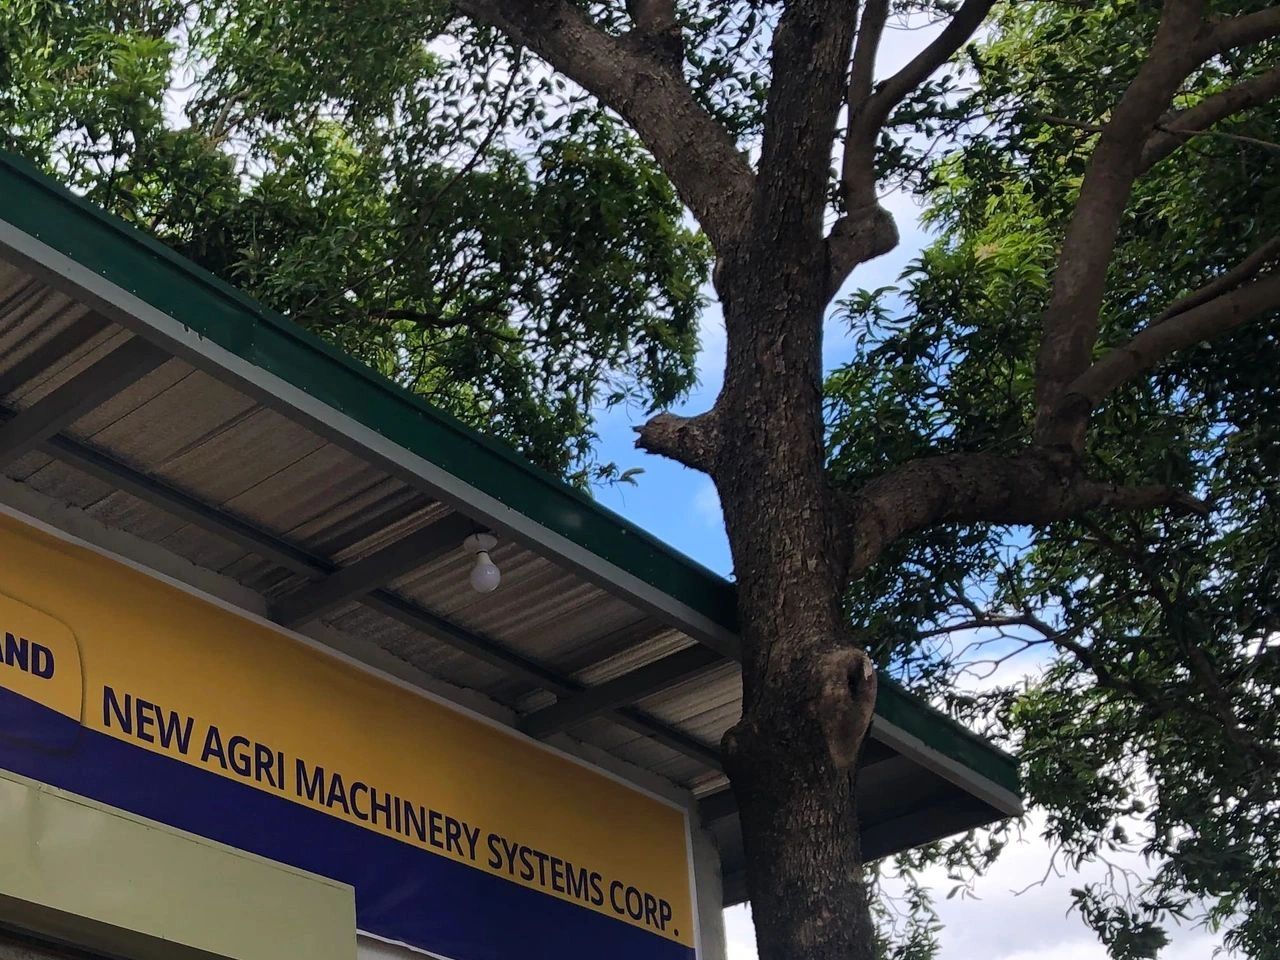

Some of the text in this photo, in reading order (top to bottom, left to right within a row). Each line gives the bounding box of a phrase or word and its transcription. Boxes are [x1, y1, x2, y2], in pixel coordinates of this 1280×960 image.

[102, 685, 679, 937] NEW AGRI MACHINERY SYSTEMS CORP.
